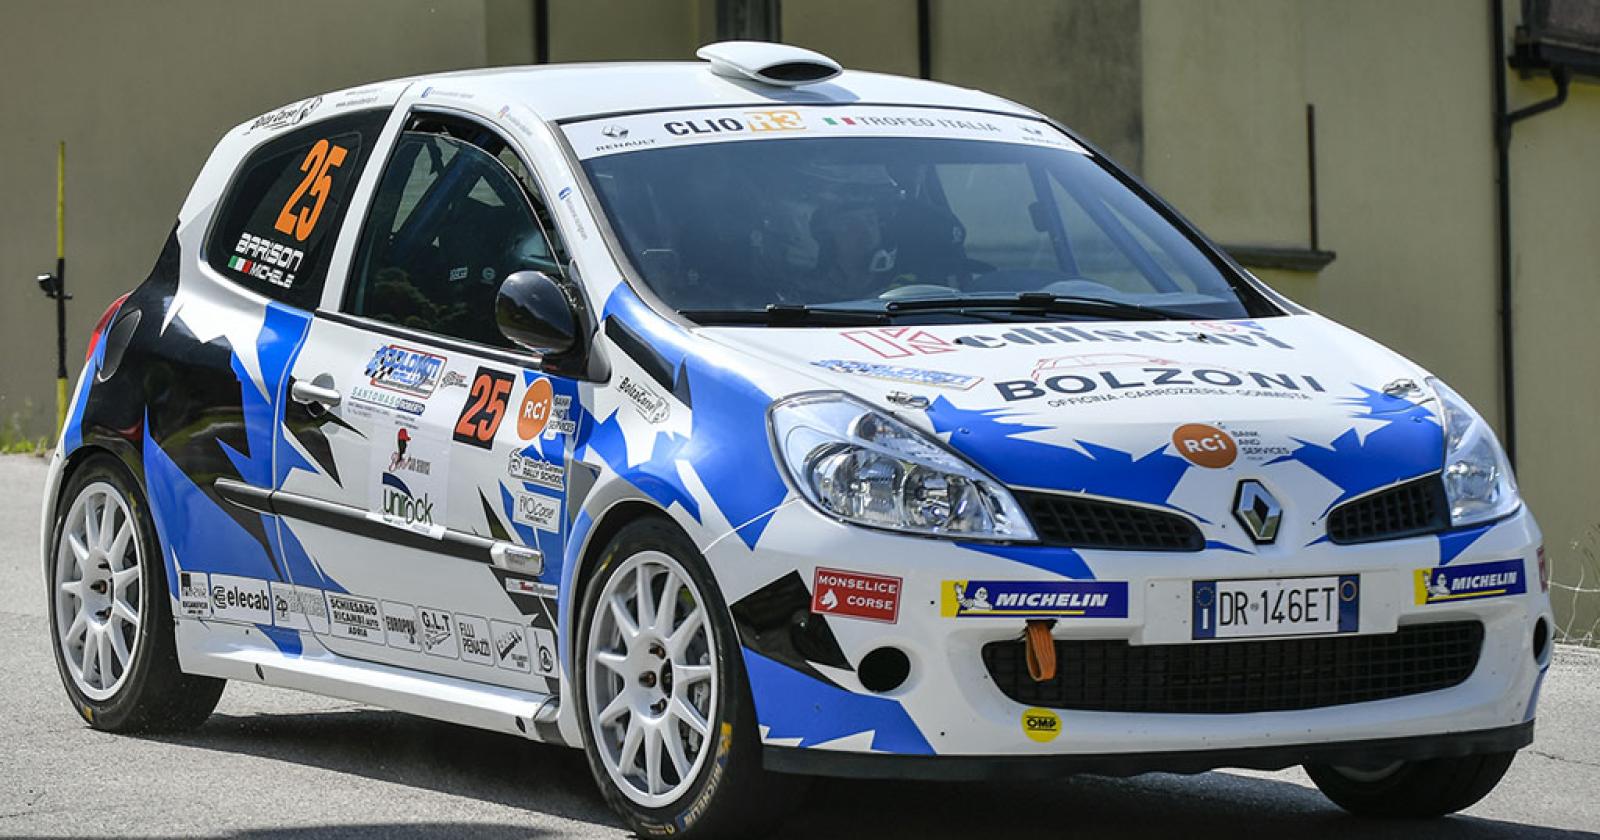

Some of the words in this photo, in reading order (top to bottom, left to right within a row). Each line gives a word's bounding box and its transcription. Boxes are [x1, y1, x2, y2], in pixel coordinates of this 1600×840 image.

[663, 117, 744, 136] CLIO
[858, 115, 936, 128] TROFEO
[939, 117, 1000, 133] ITALIA
[595, 138, 656, 152] RENAULT
[274, 139, 348, 242] 25
[235, 232, 304, 273] BARISON
[994, 366, 1326, 402] BOLZONI
[455, 373, 513, 441] 25
[1047, 393, 1118, 410] OFFICINA
[818, 575, 897, 595] MONSELICE
[1451, 572, 1517, 591] MICHELIN
[227, 586, 270, 612] elecab
[847, 596, 893, 611] CORSE
[995, 592, 1109, 608] MICHELIN
[1219, 591, 1249, 626] DR
[1260, 587, 1336, 625] 146ET
[1026, 717, 1057, 730] OMP
